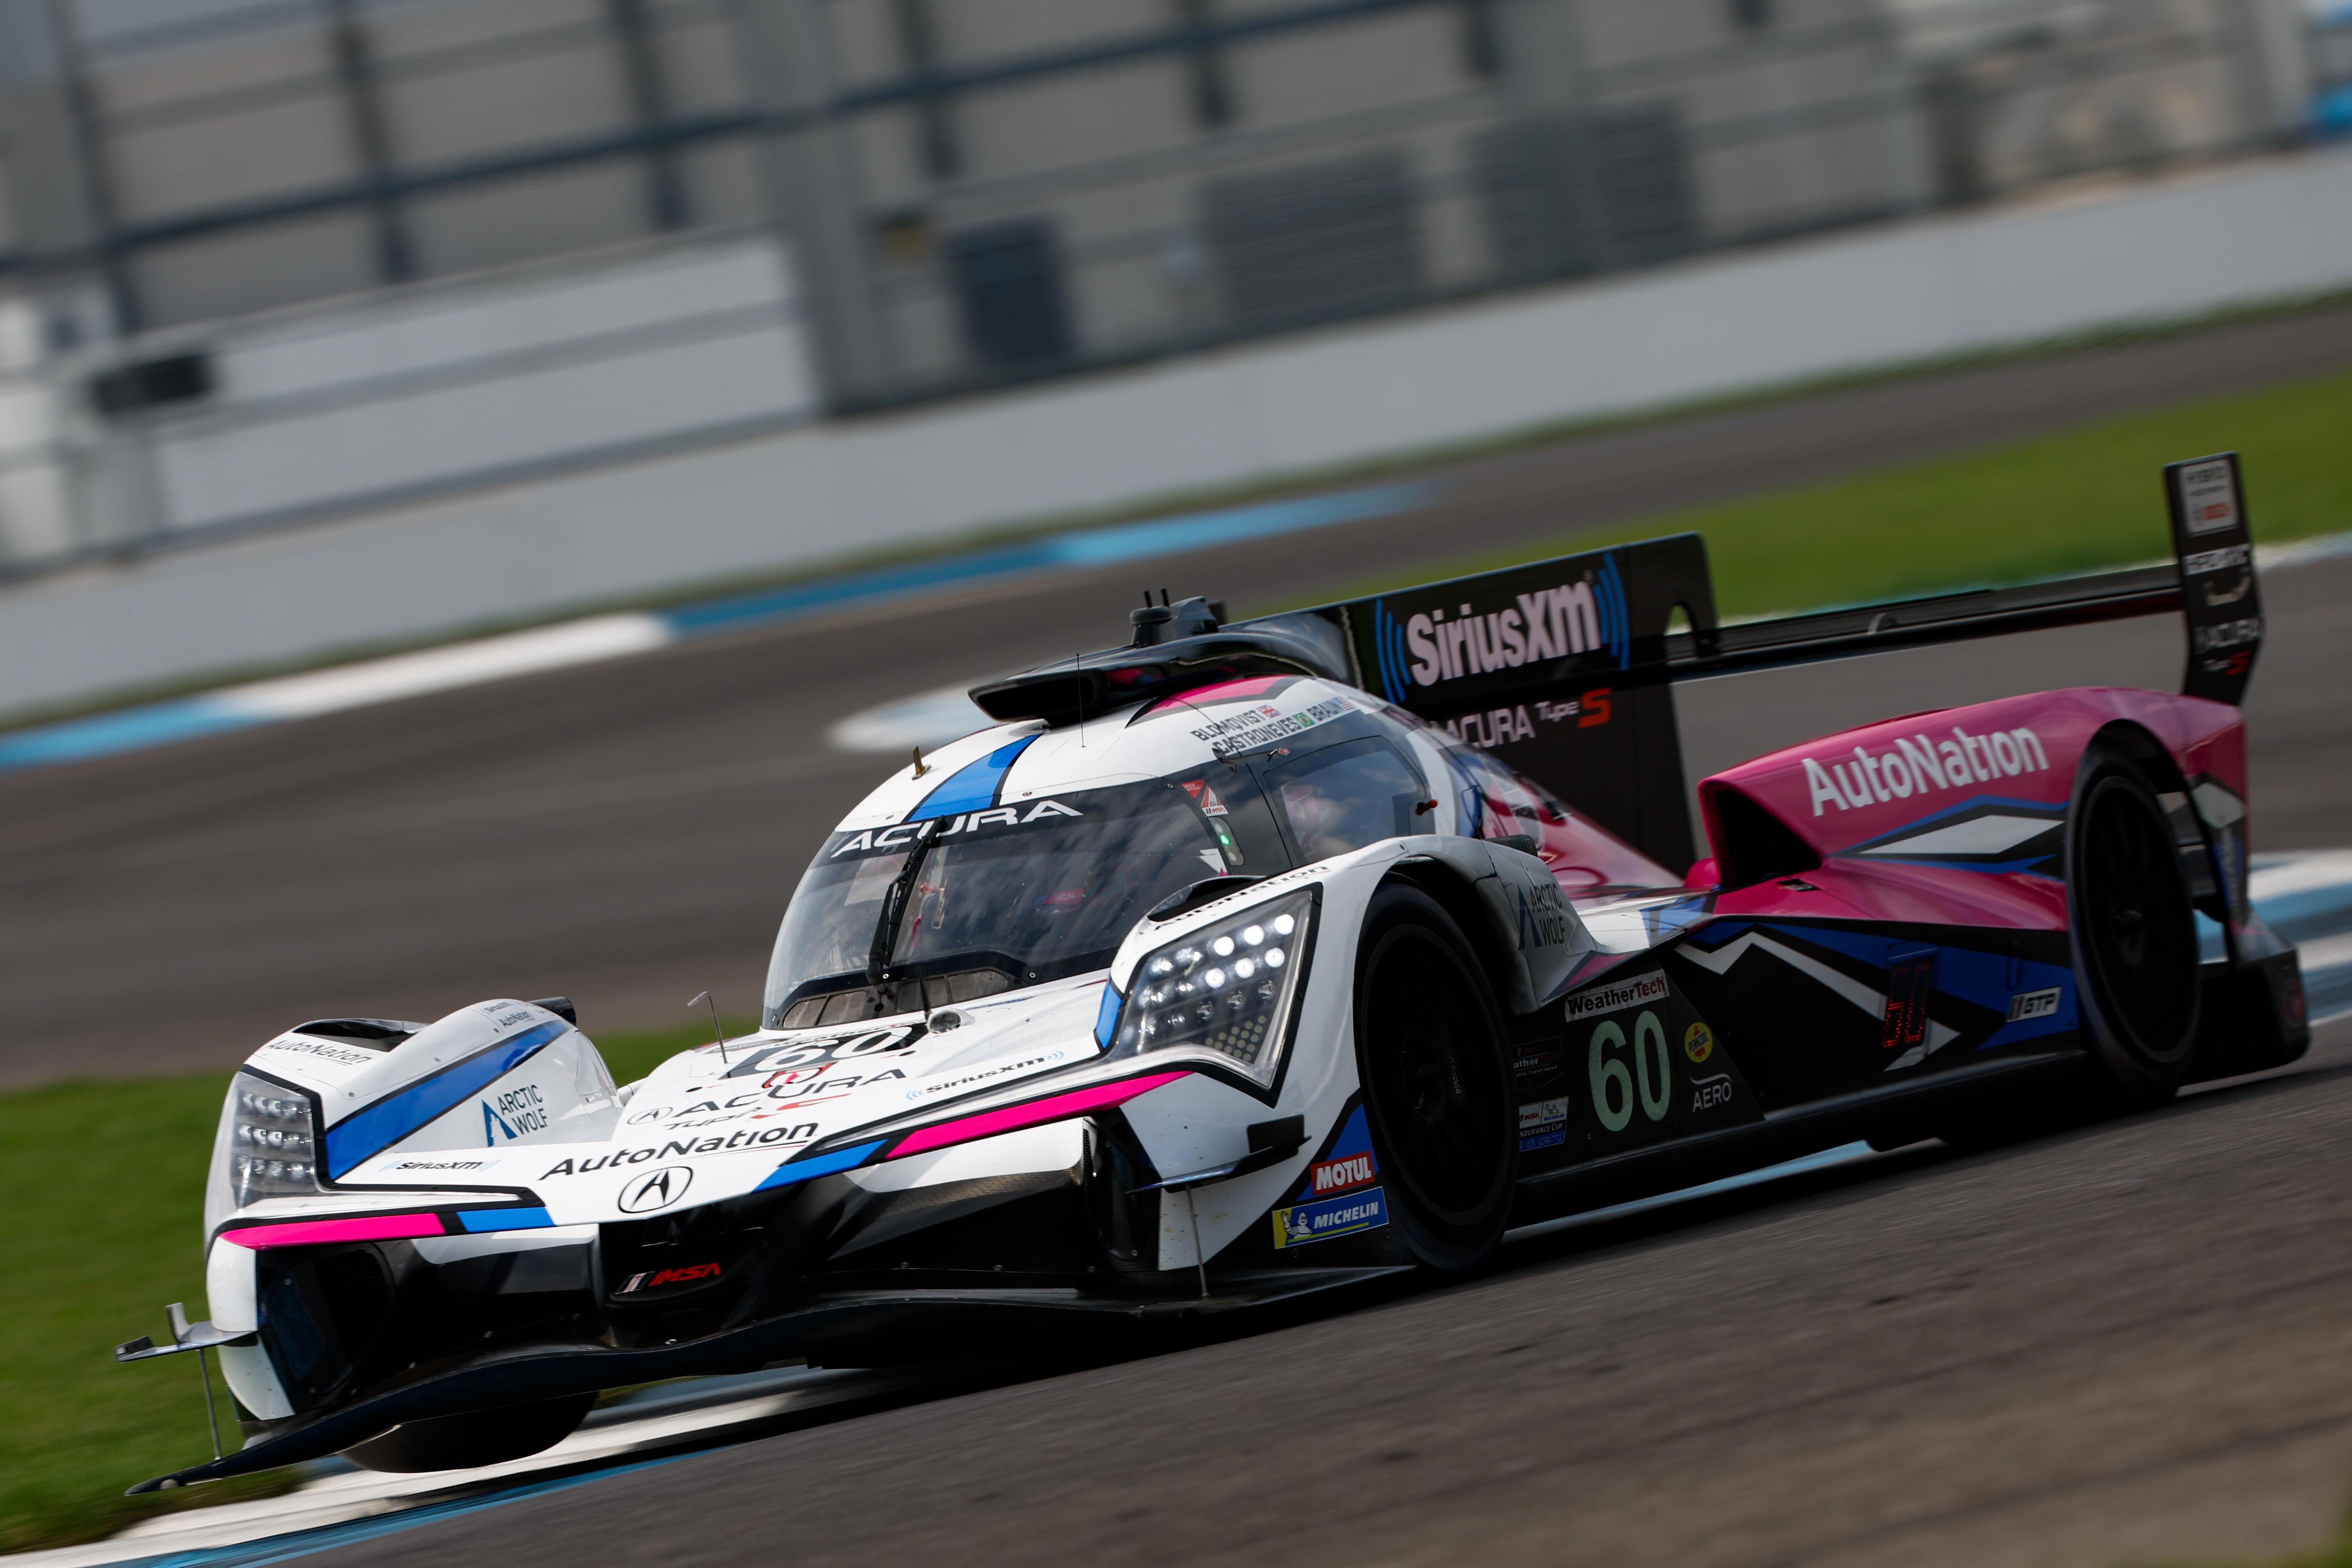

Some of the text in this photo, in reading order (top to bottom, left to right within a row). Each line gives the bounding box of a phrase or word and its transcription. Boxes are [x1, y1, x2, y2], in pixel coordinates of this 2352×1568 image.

[1534, 700, 1579, 722] Type
[1578, 687, 1612, 728] S
[1190, 710, 1265, 741] BLOMQVIST
[1211, 717, 1302, 754] CASTRONEVES
[1801, 726, 2049, 817] AutoNation
[830, 800, 1084, 858] ACURA
[1529, 883, 1562, 913] ARCTIC
[1539, 916, 1565, 946] WOLF
[1568, 977, 1666, 1015] WeatherTech
[2024, 993, 2055, 1014] GTP
[266, 1039, 373, 1064] AutoNation
[755, 1026, 912, 1071] 60
[1588, 1010, 1671, 1132] 60
[497, 1084, 543, 1115] ARCTIC
[671, 1068, 908, 1119] ACURA
[1692, 1082, 1732, 1113] AERO
[511, 1108, 548, 1135] WOLF
[537, 1122, 819, 1181] AutoNation
[1316, 1156, 1372, 1191] MOTUL
[1314, 1201, 1378, 1229] MICHELIN
[648, 1262, 721, 1287] IMSA
